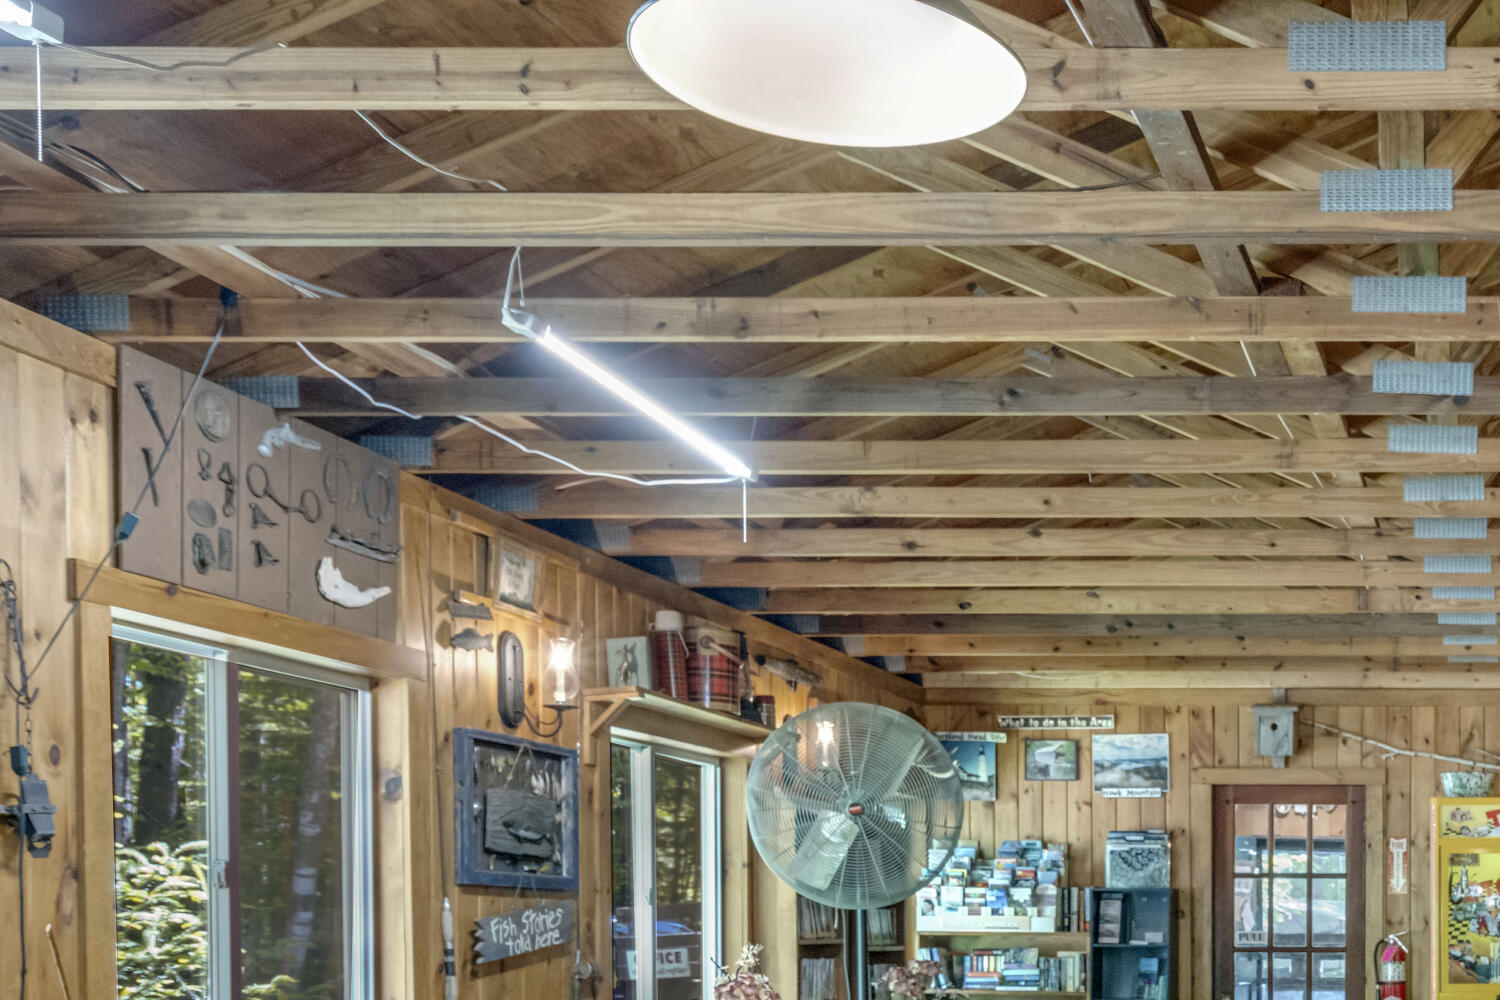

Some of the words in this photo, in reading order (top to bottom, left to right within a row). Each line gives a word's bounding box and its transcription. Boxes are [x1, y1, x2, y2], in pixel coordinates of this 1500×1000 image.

[998, 718, 1025, 728] What
[1028, 718, 1040, 728] to
[1042, 718, 1055, 728] do
[1069, 717, 1087, 728] the
[490, 916, 518, 944] Fish
[521, 907, 564, 934] Stories
[504, 933, 532, 956] told
[534, 929, 564, 950] here
